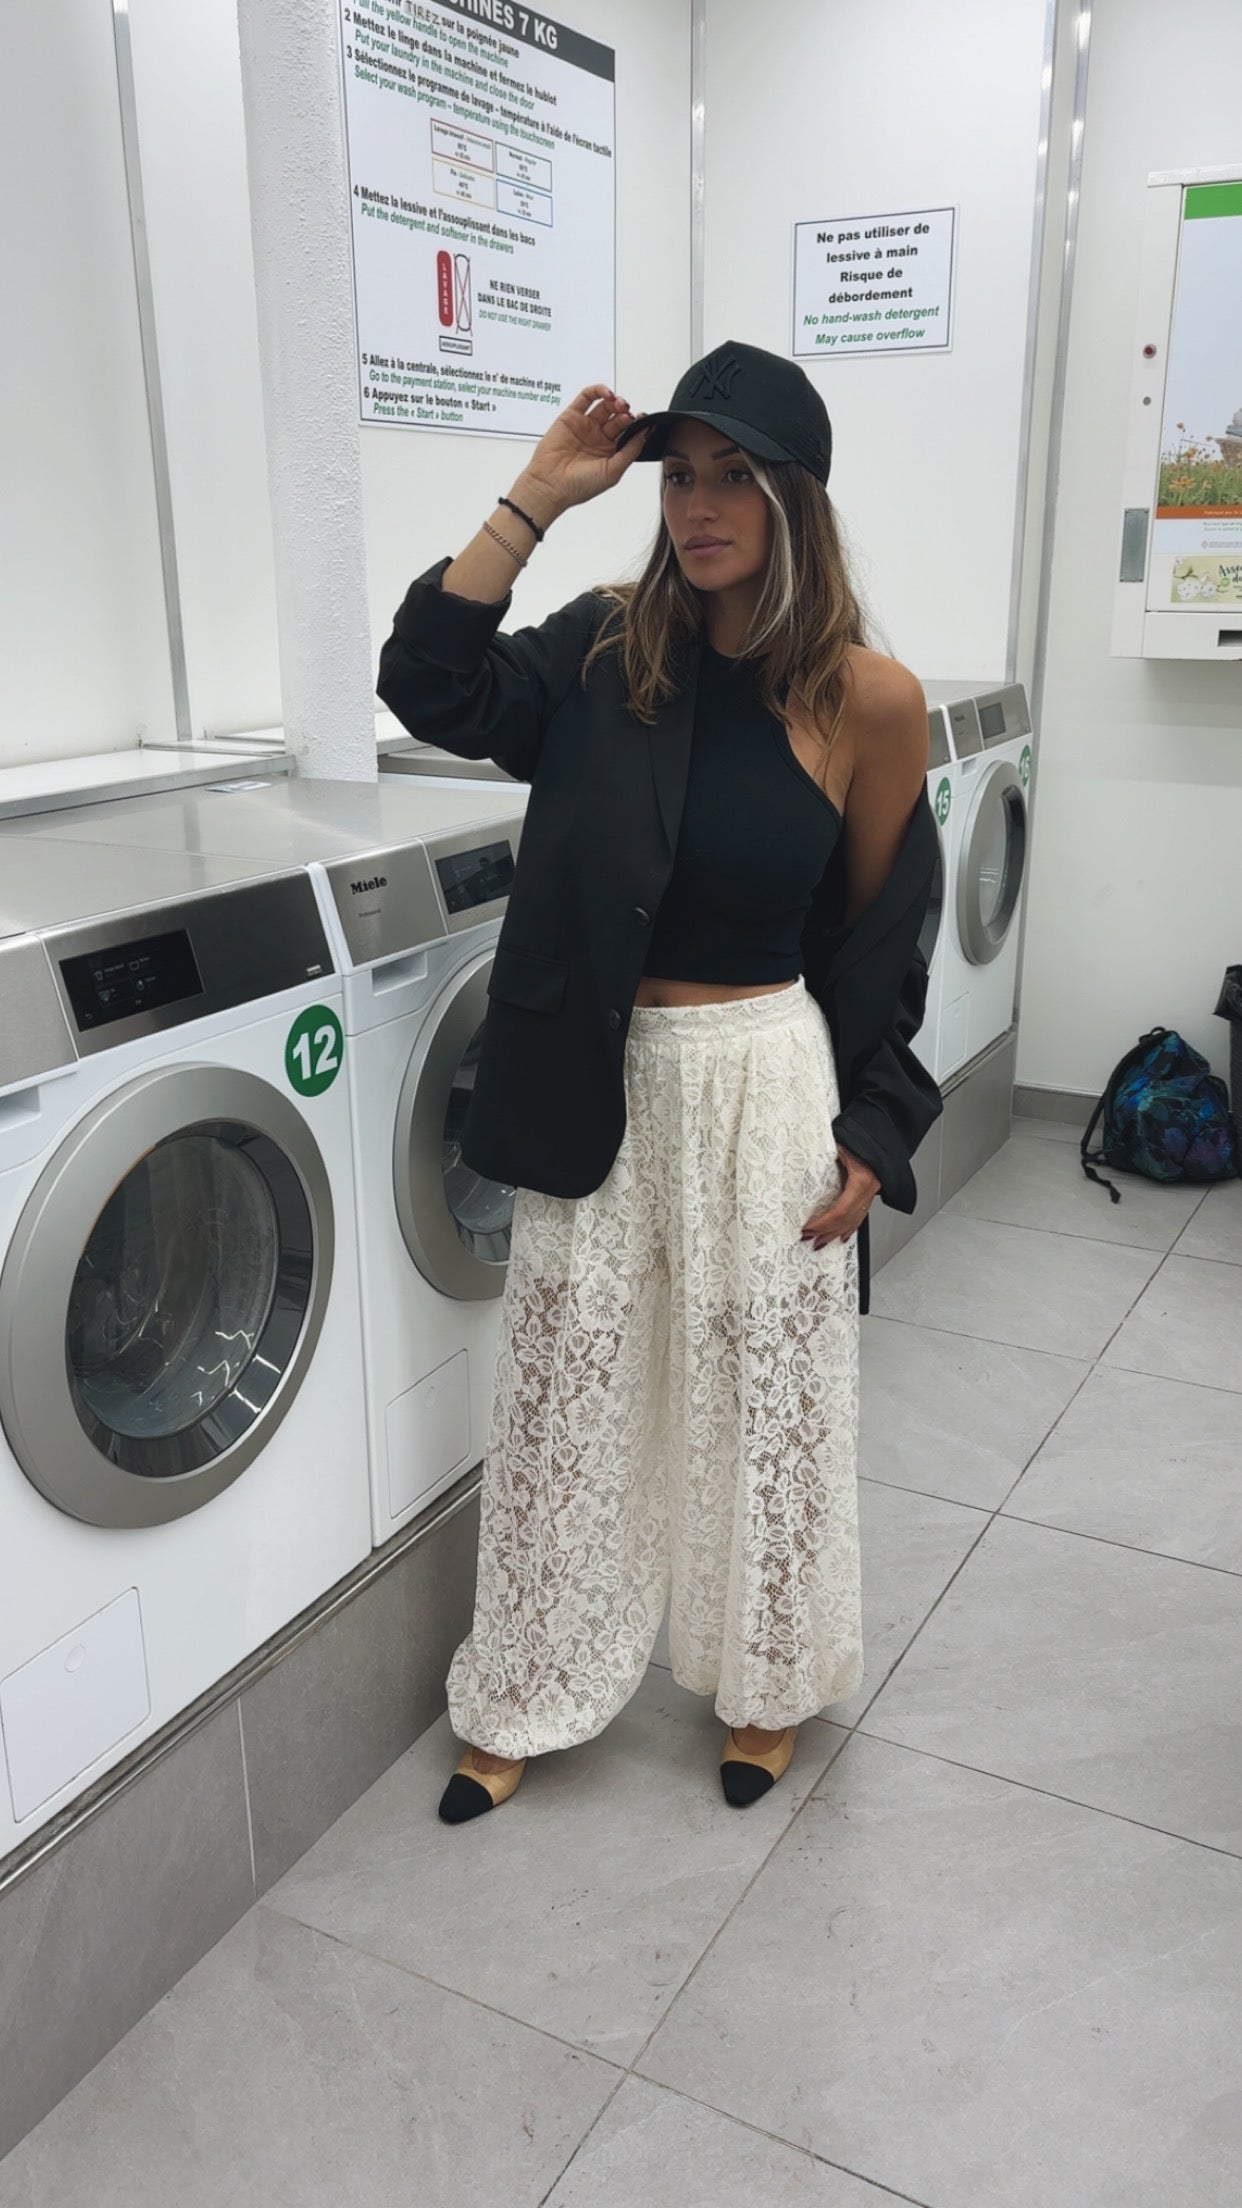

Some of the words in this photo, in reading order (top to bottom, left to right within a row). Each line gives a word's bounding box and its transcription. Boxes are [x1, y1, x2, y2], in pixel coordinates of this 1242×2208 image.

[371, 0, 384, 15] the
[442, 17, 454, 30] sur
[456, 20, 465, 34] la
[467, 27, 497, 49] poignée
[499, 39, 519, 59] jaune
[519, 11, 529, 36] 7
[534, 18, 558, 50] KG
[344, 8, 351, 22] 2
[353, 11, 386, 36] Mettez
[388, 25, 396, 40] le
[398, 30, 420, 51] linge
[422, 41, 442, 59] dans
[444, 49, 452, 63] la
[454, 55, 488, 77] machine
[489, 70, 497, 81] et
[499, 71, 525, 93] fermez
[526, 83, 533, 96] le
[535, 87, 557, 106] hublot
[355, 29, 370, 46] Put
[371, 38, 390, 53] your
[391, 42, 420, 68] laundry
[421, 55, 430, 69] in
[431, 59, 442, 75] the
[444, 66, 473, 87] machine
[475, 79, 488, 92] and
[489, 84, 507, 100] close
[508, 91, 518, 104] the
[519, 96, 535, 110] door
[346, 45, 353, 59] 3
[354, 48, 407, 79] Sélectionnez
[409, 68, 416, 82] le
[417, 75, 459, 100] programme
[460, 90, 470, 103] de
[471, 93, 494, 113] lavage
[500, 105, 540, 130] température
[564, 131, 571, 142] de
[353, 184, 359, 198] 4
[360, 186, 390, 206] Mettez
[391, 194, 399, 208] la
[400, 197, 427, 216] lessive
[429, 207, 437, 219] et
[438, 208, 491, 234] l'assouplissant
[491, 224, 508, 239] dans
[509, 229, 518, 242] les
[519, 232, 535, 246] bacs
[361, 202, 375, 218] Put
[376, 207, 389, 222] the
[390, 211, 425, 231] detergent
[427, 222, 440, 235] and
[441, 226, 469, 242] softener
[470, 233, 477, 244] in
[478, 235, 488, 248] the
[489, 238, 514, 254] drawers
[816, 232, 834, 244] Ne
[838, 231, 861, 245] pas
[864, 225, 911, 239] utiliser
[913, 223, 930, 235] de
[826, 251, 871, 263] lessive
[874, 248, 883, 259] à
[886, 245, 918, 258] main
[840, 269, 884, 283] Risque
[887, 267, 903, 279] de
[490, 279, 498, 291] NE
[500, 281, 515, 295] RIEN
[516, 285, 540, 300] VERSER
[828, 287, 913, 304] débordement
[478, 292, 495, 305] DANS
[496, 297, 505, 308] LE
[506, 298, 518, 310] BAC
[520, 301, 529, 312] DE
[530, 303, 551, 318] DROITE
[803, 315, 819, 326] No
[821, 309, 883, 325] hand-wash
[884, 305, 940, 321] detergent
[815, 333, 838, 346] May
[840, 331, 873, 343] cause
[876, 328, 926, 341] overflow
[361, 353, 368, 365] 5
[369, 354, 389, 368] Allez
[391, 356, 396, 369] à
[397, 358, 405, 370] la
[440, 365, 483, 381] sélectionnez
[485, 371, 492, 382] le
[500, 374, 509, 385] de
[510, 376, 535, 389] machine
[536, 379, 543, 389] et
[544, 382, 561, 393] payez
[369, 369, 380, 381] Go
[381, 372, 389, 382] to
[390, 373, 401, 385] the
[402, 376, 432, 389] payment
[458, 382, 476, 394] select
[477, 386, 491, 397] your
[492, 387, 516, 400] machine
[517, 391, 539, 402] number
[690, 354, 742, 400] NY
[363, 386, 370, 398] 6
[372, 388, 409, 404] Appuyez
[410, 395, 424, 404] sur
[425, 393, 433, 405] le
[435, 395, 463, 409] bouton
[471, 399, 490, 411] Start
[373, 402, 395, 415] Press
[396, 404, 409, 417] the
[416, 407, 434, 419] Start
[440, 410, 463, 422] button
[937, 789, 950, 818] 15
[350, 875, 388, 895] Miele
[292, 1024, 338, 1081] 12
